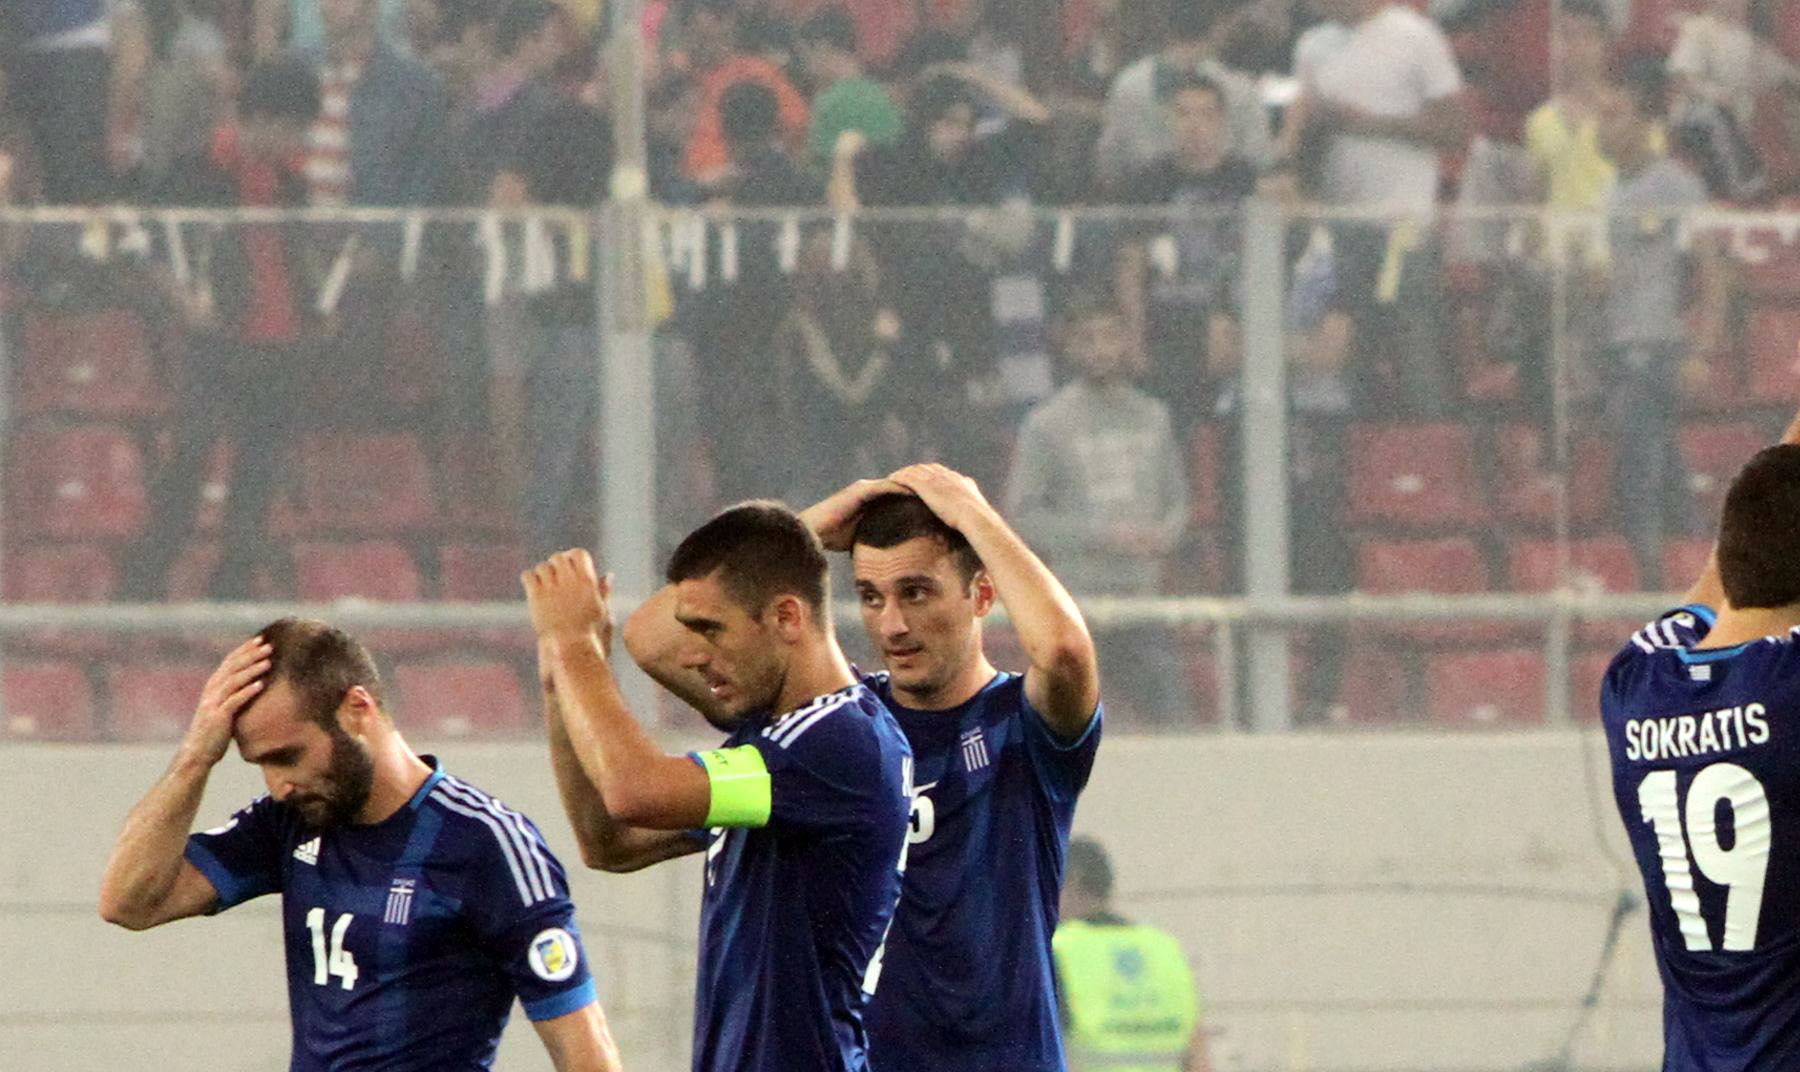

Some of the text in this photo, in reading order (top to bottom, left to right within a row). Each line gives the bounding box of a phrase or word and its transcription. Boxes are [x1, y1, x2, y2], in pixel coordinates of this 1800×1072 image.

[1625, 702, 1770, 761] SOKRATIS
[907, 780, 938, 844] 5
[1637, 762, 1772, 952] 19
[306, 907, 359, 991] 14
